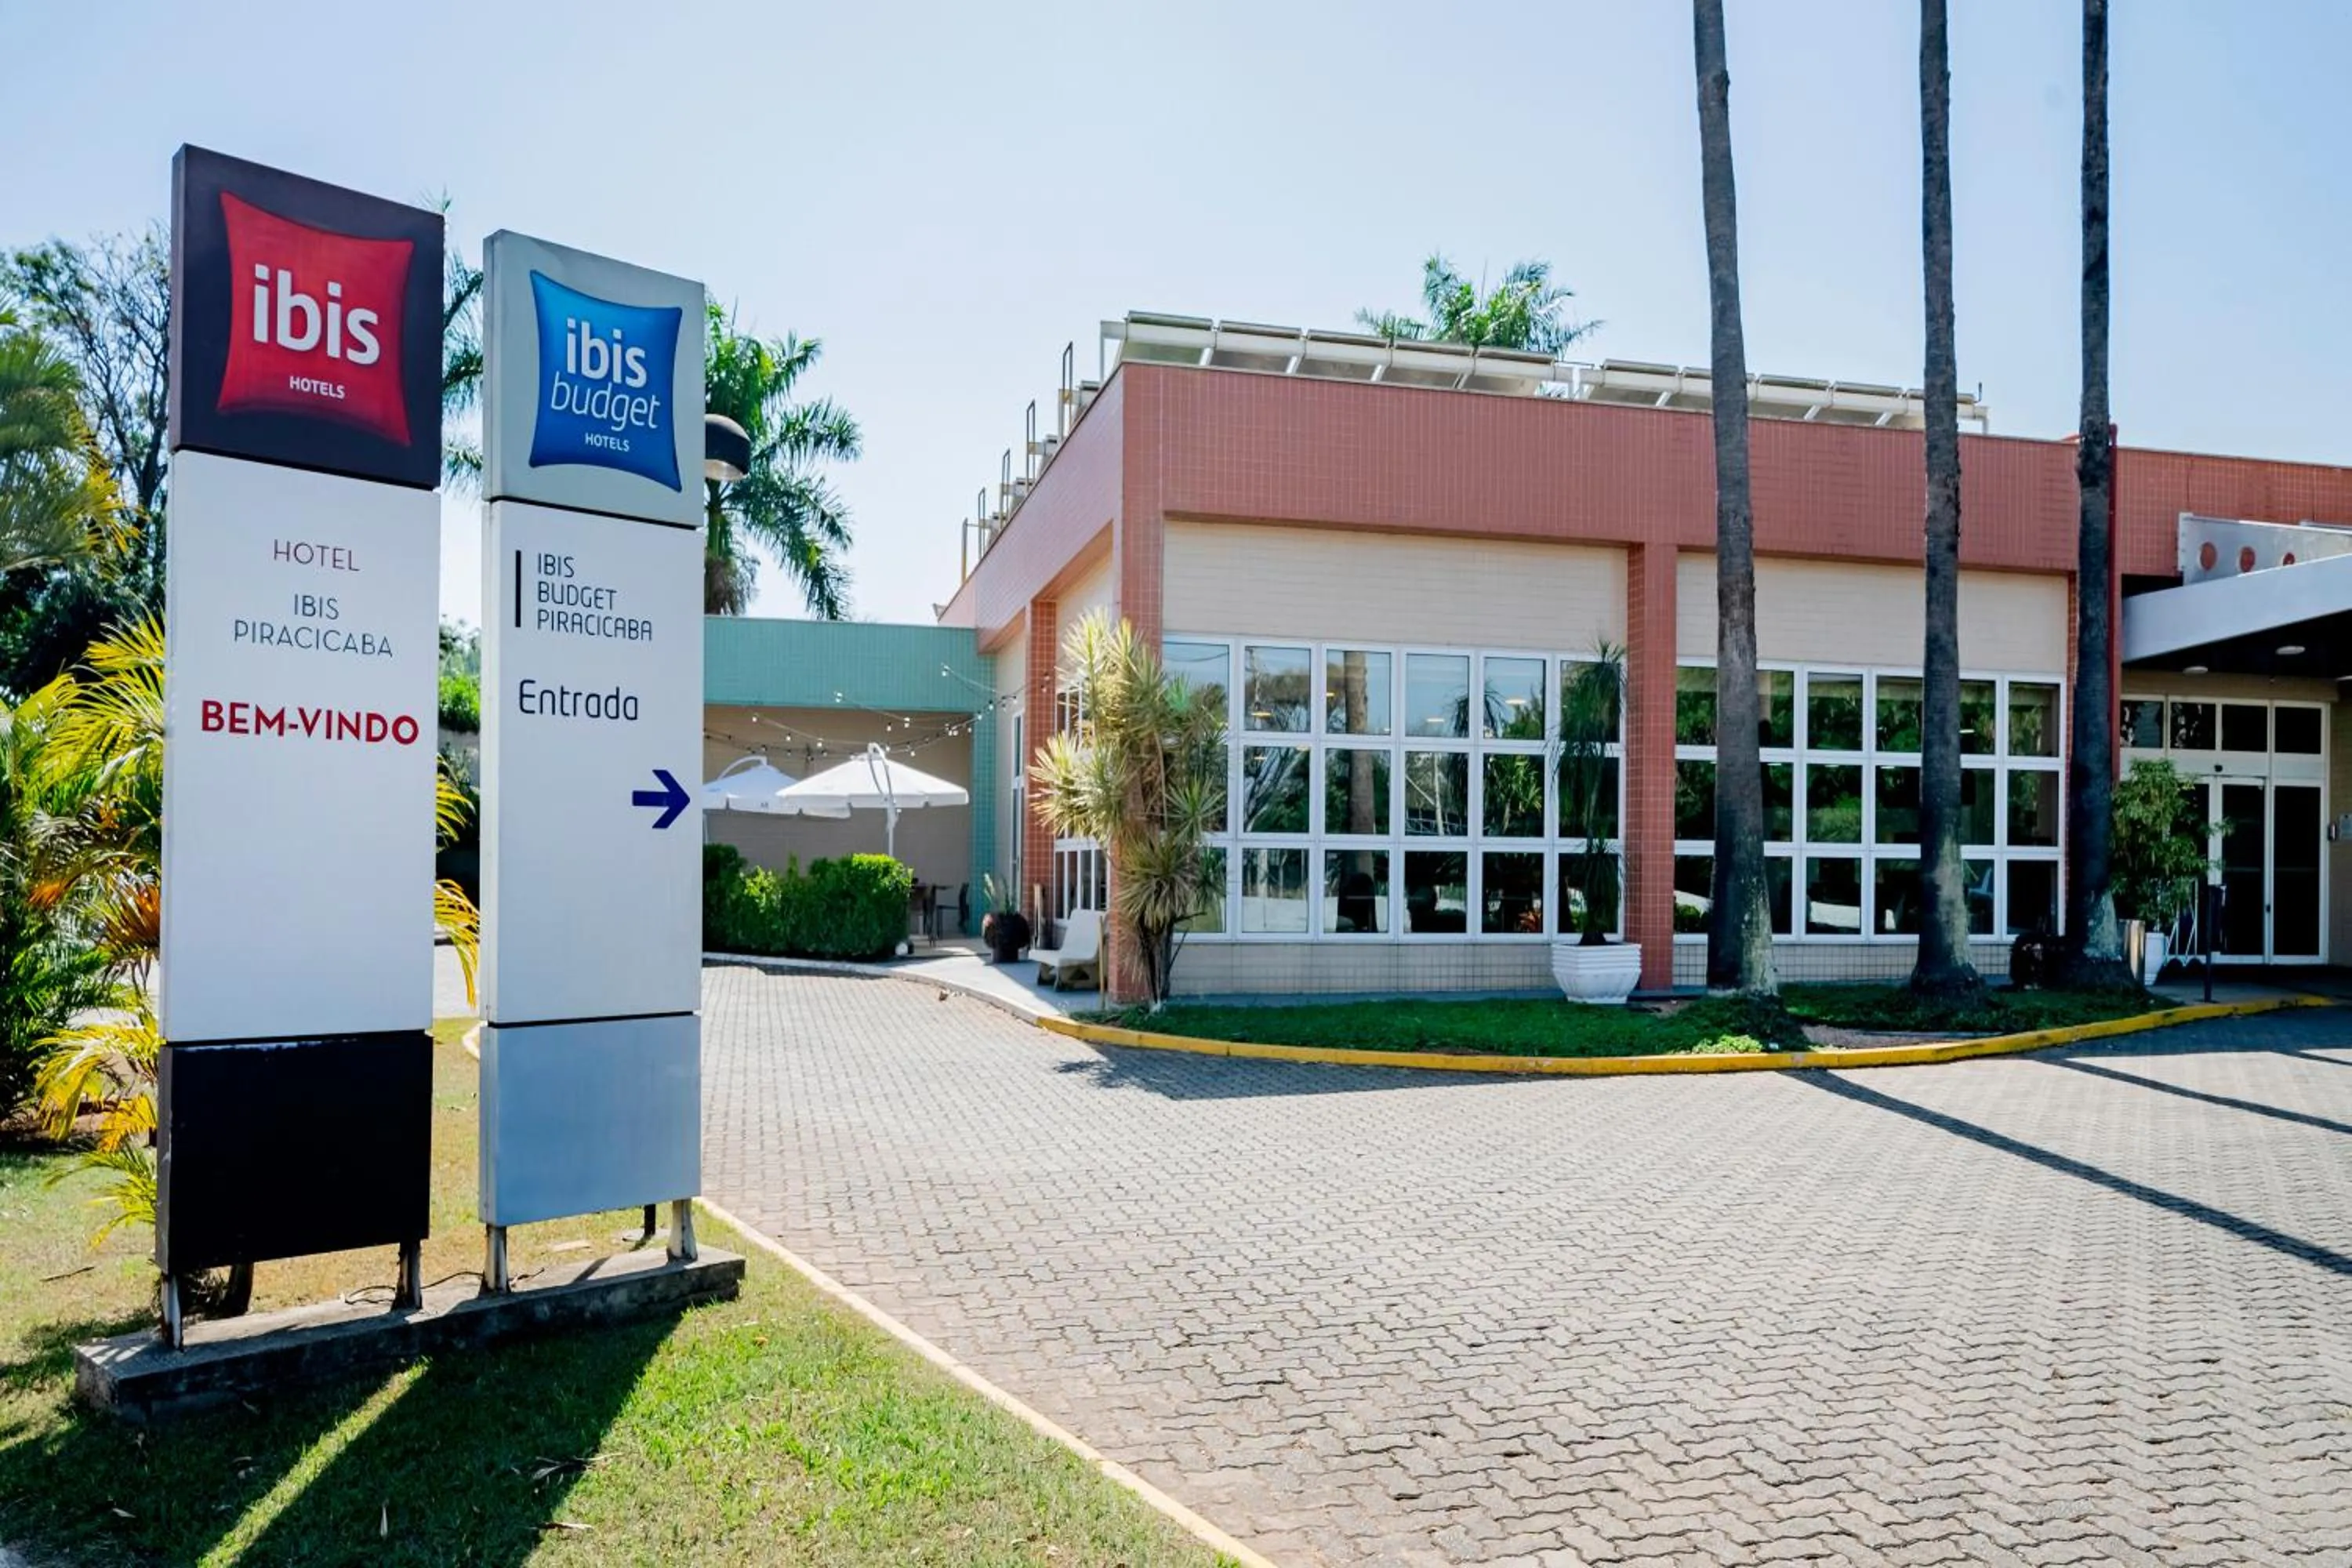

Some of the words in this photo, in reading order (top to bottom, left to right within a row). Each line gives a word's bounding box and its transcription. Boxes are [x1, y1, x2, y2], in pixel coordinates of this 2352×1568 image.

[254, 263, 380, 365] ibis
[567, 318, 648, 388] ibis
[289, 376, 346, 400] HOTELS
[550, 371, 661, 431] budget
[586, 433, 630, 452] HOTELS
[274, 539, 361, 572] HOTEL
[538, 554, 575, 578] IBIS
[294, 593, 339, 620] IBIS
[538, 581, 617, 610] BUDGET
[234, 619, 393, 658] PIRACICABA
[538, 609, 652, 641] PIRACICABA
[519, 680, 638, 720] Entrada
[201, 699, 419, 745] BEM-VINDO
